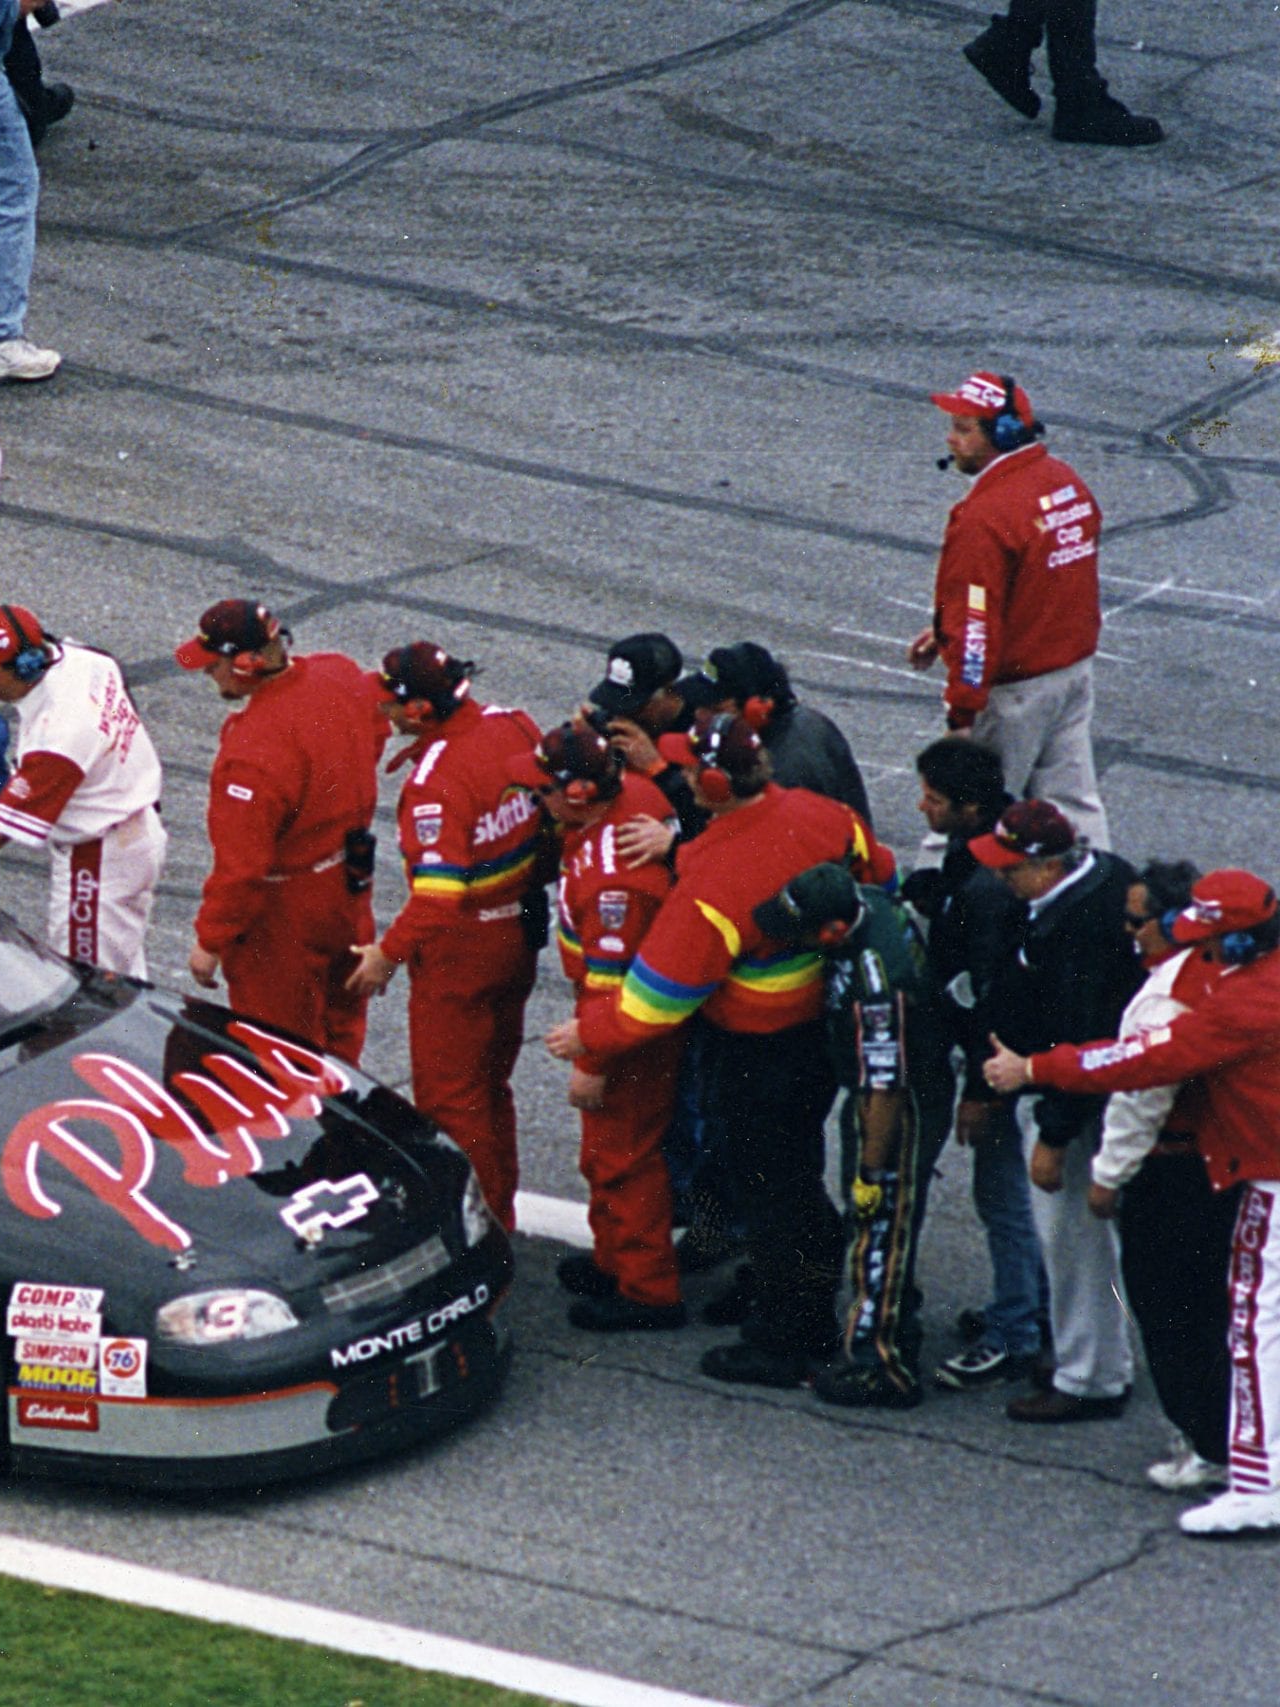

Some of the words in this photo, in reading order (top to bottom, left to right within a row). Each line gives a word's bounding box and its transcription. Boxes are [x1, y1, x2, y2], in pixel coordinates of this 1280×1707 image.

[1056, 525, 1083, 545] Cup
[71, 868, 99, 923] Cup
[0, 1021, 352, 1251] Plus
[1239, 1192, 1268, 1249] Cup
[17, 1286, 76, 1307] COMP
[1232, 1252, 1256, 1360] Winston
[11, 1309, 92, 1334] plasti-kote
[330, 1321, 423, 1368] MONTE
[427, 1284, 489, 1333] CARLO
[22, 1342, 89, 1364] SIMPSON
[110, 1350, 136, 1368] 76
[18, 1364, 97, 1389] MOOG
